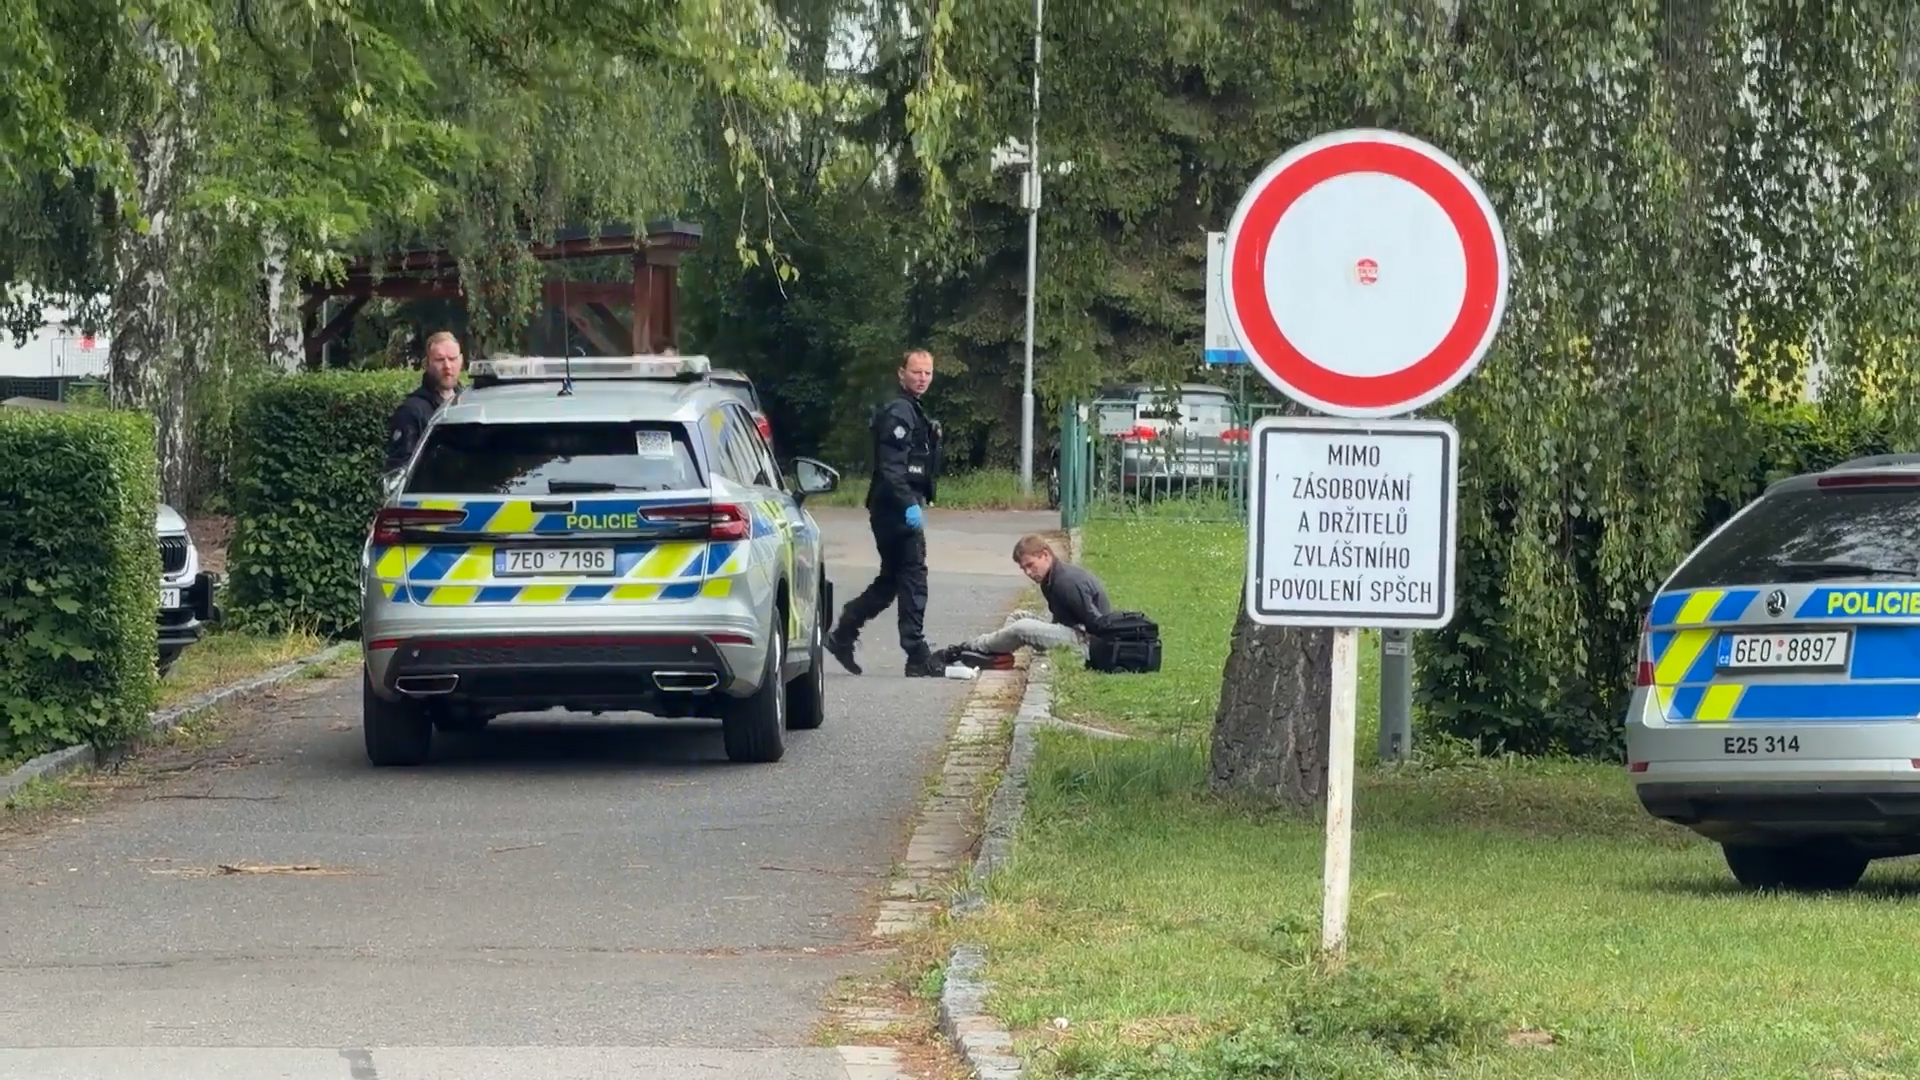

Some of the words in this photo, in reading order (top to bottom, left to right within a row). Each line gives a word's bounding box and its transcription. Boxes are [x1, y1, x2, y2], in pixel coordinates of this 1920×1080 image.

[1327, 444, 1381, 467] MIMO
[1292, 472, 1413, 501] ZÁSOBOVÁNÍ
[566, 514, 639, 529] POLICIE
[1298, 511, 1310, 533] A
[1319, 505, 1408, 535] DRŽITELŮ
[560, 551, 605, 569] 7196
[1293, 540, 1410, 569] ZVLÁŠTNÍHO
[161, 591, 174, 606] 21
[1269, 574, 1364, 602] POVOLENÍ
[1370, 575, 1432, 604] SPŠCH
[1827, 591, 1920, 615] POLICIE
[1787, 637, 1837, 662] 8897
[1724, 736, 1758, 754] E25
[1765, 735, 1800, 753] 314
